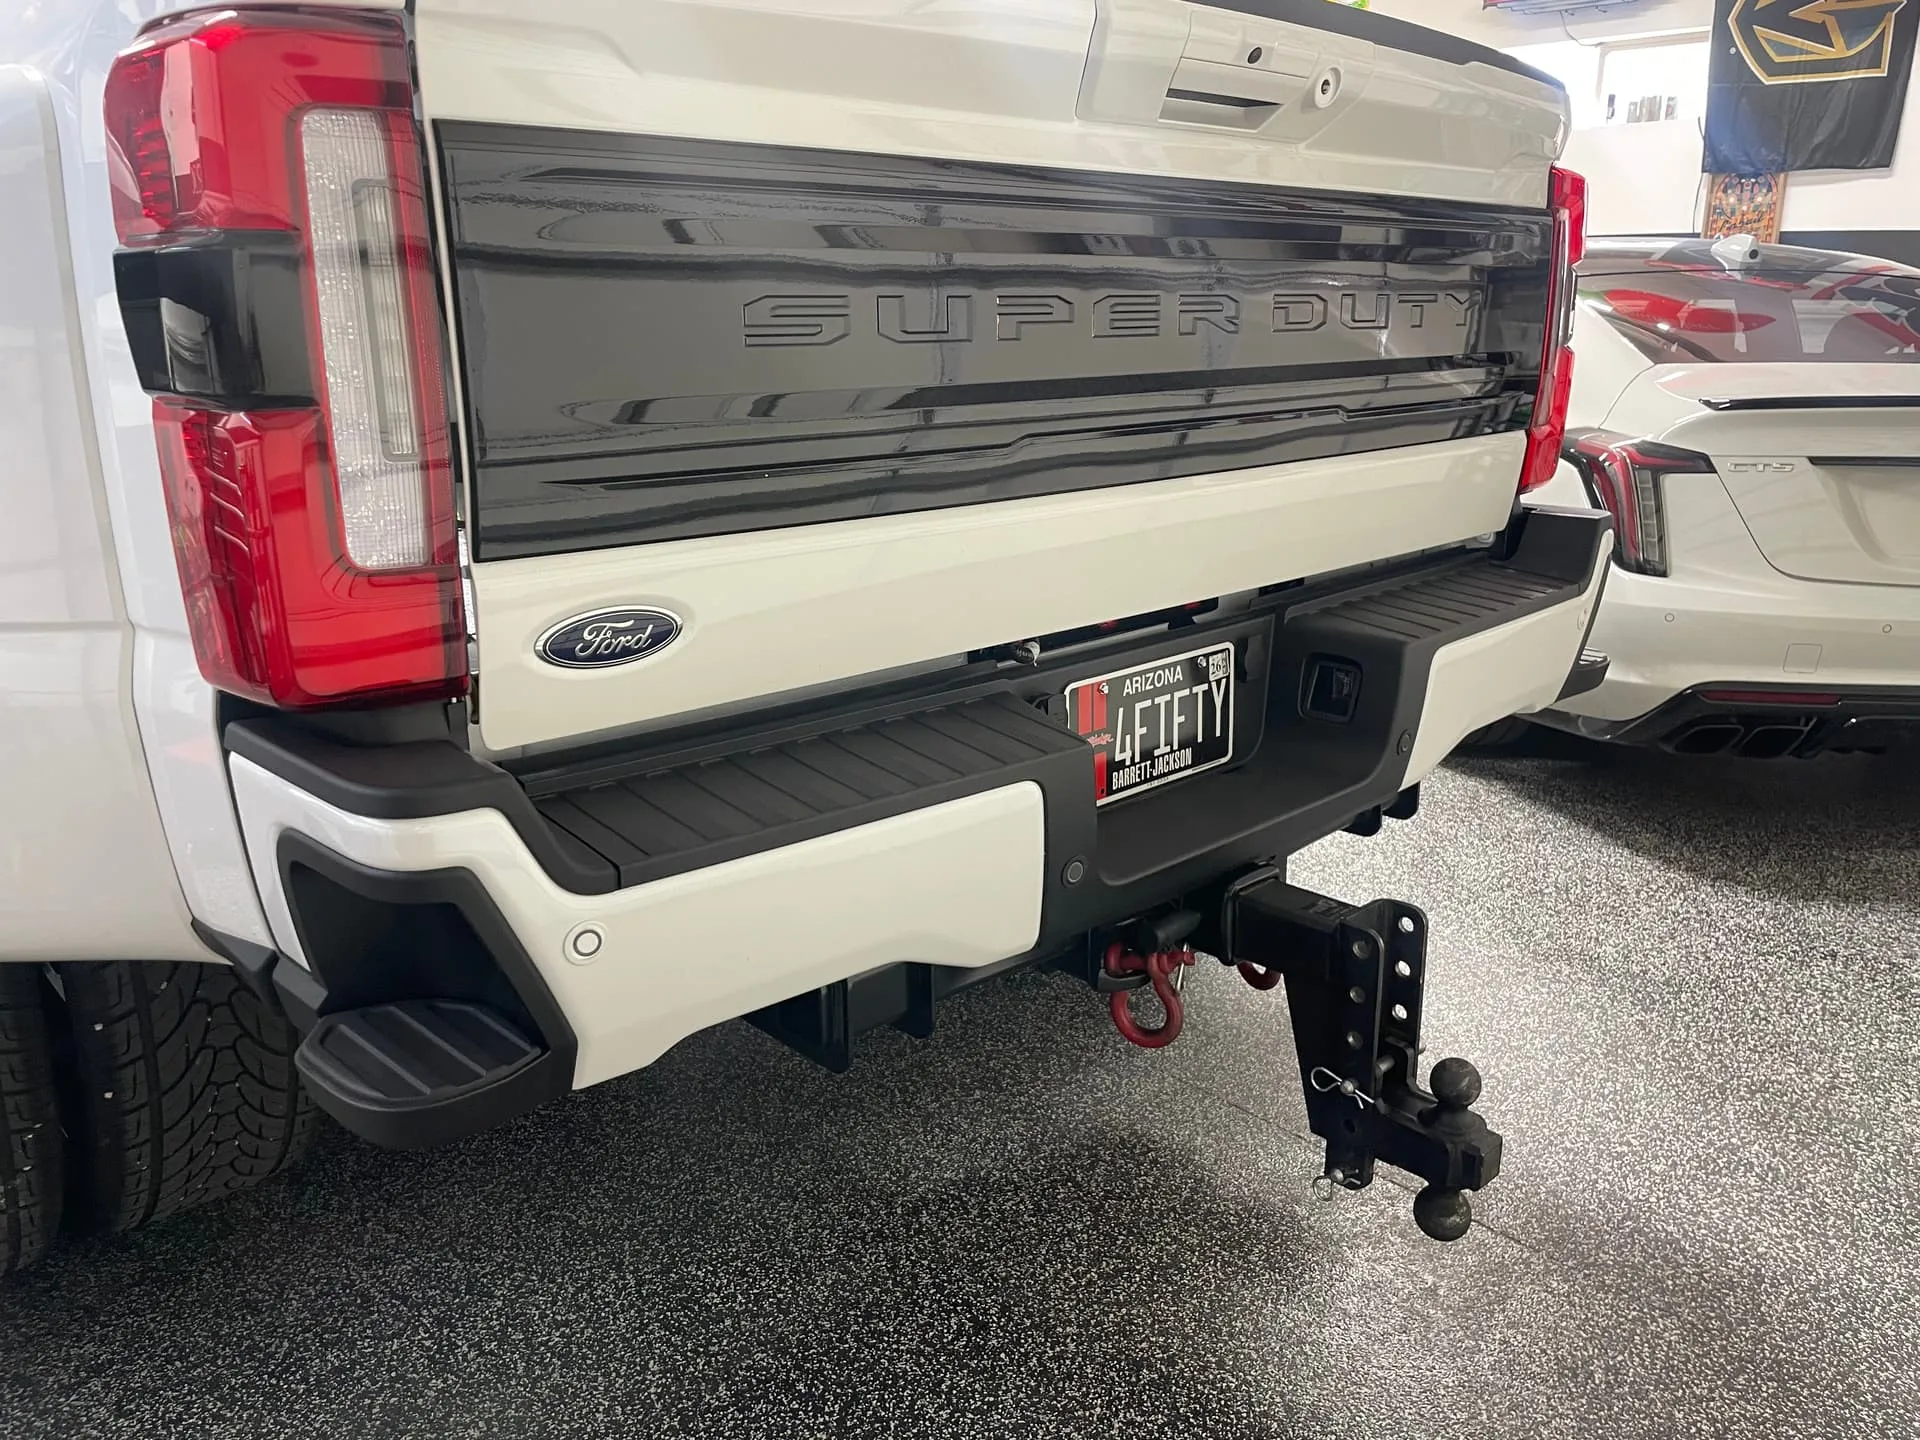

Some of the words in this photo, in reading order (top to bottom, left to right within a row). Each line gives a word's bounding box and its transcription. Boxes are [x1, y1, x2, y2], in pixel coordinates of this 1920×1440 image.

[743, 294, 1241, 347] SUPER
[1272, 292, 1481, 335] DUTY
[575, 620, 654, 657] Ford
[1123, 665, 1183, 697] ARIZONA
[1115, 678, 1227, 766] 4FIFTY
[1112, 747, 1192, 791] BARRETT-JACKSON
